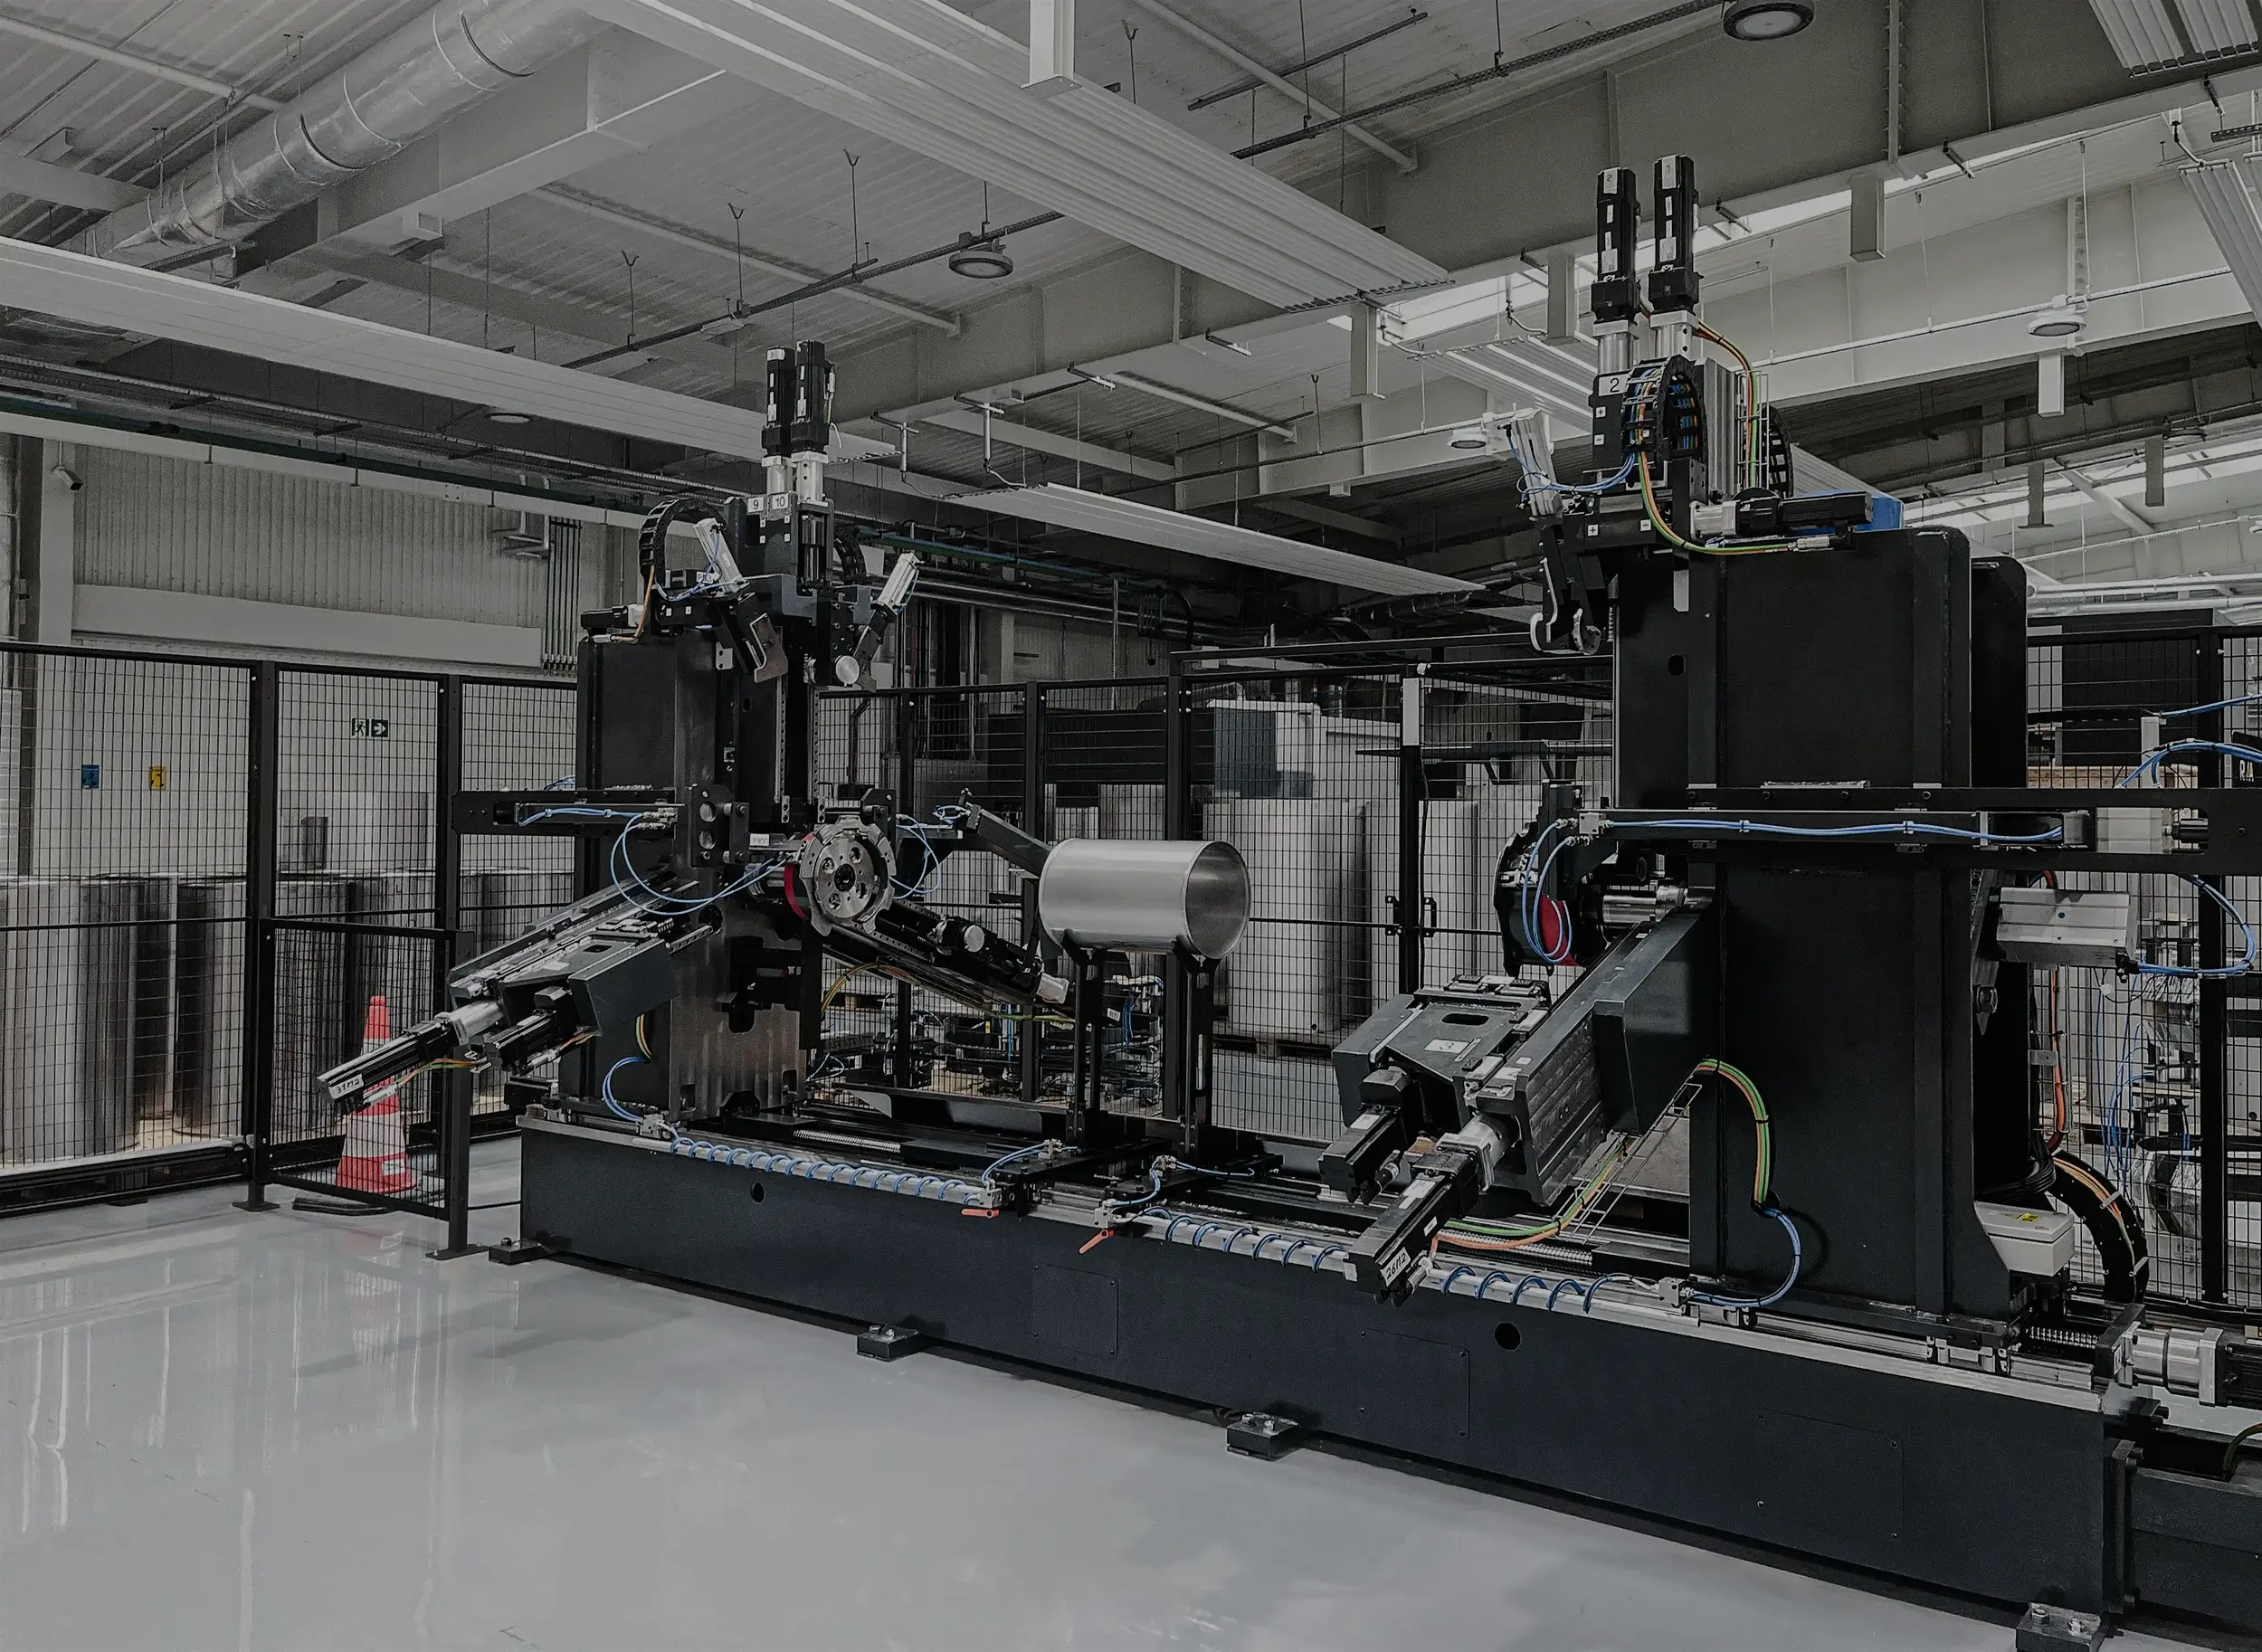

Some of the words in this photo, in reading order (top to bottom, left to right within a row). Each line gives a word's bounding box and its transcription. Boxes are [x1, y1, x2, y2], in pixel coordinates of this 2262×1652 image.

[1610, 377, 1620, 393] 2
[753, 499, 759, 510] 9
[775, 496, 785, 508] 10
